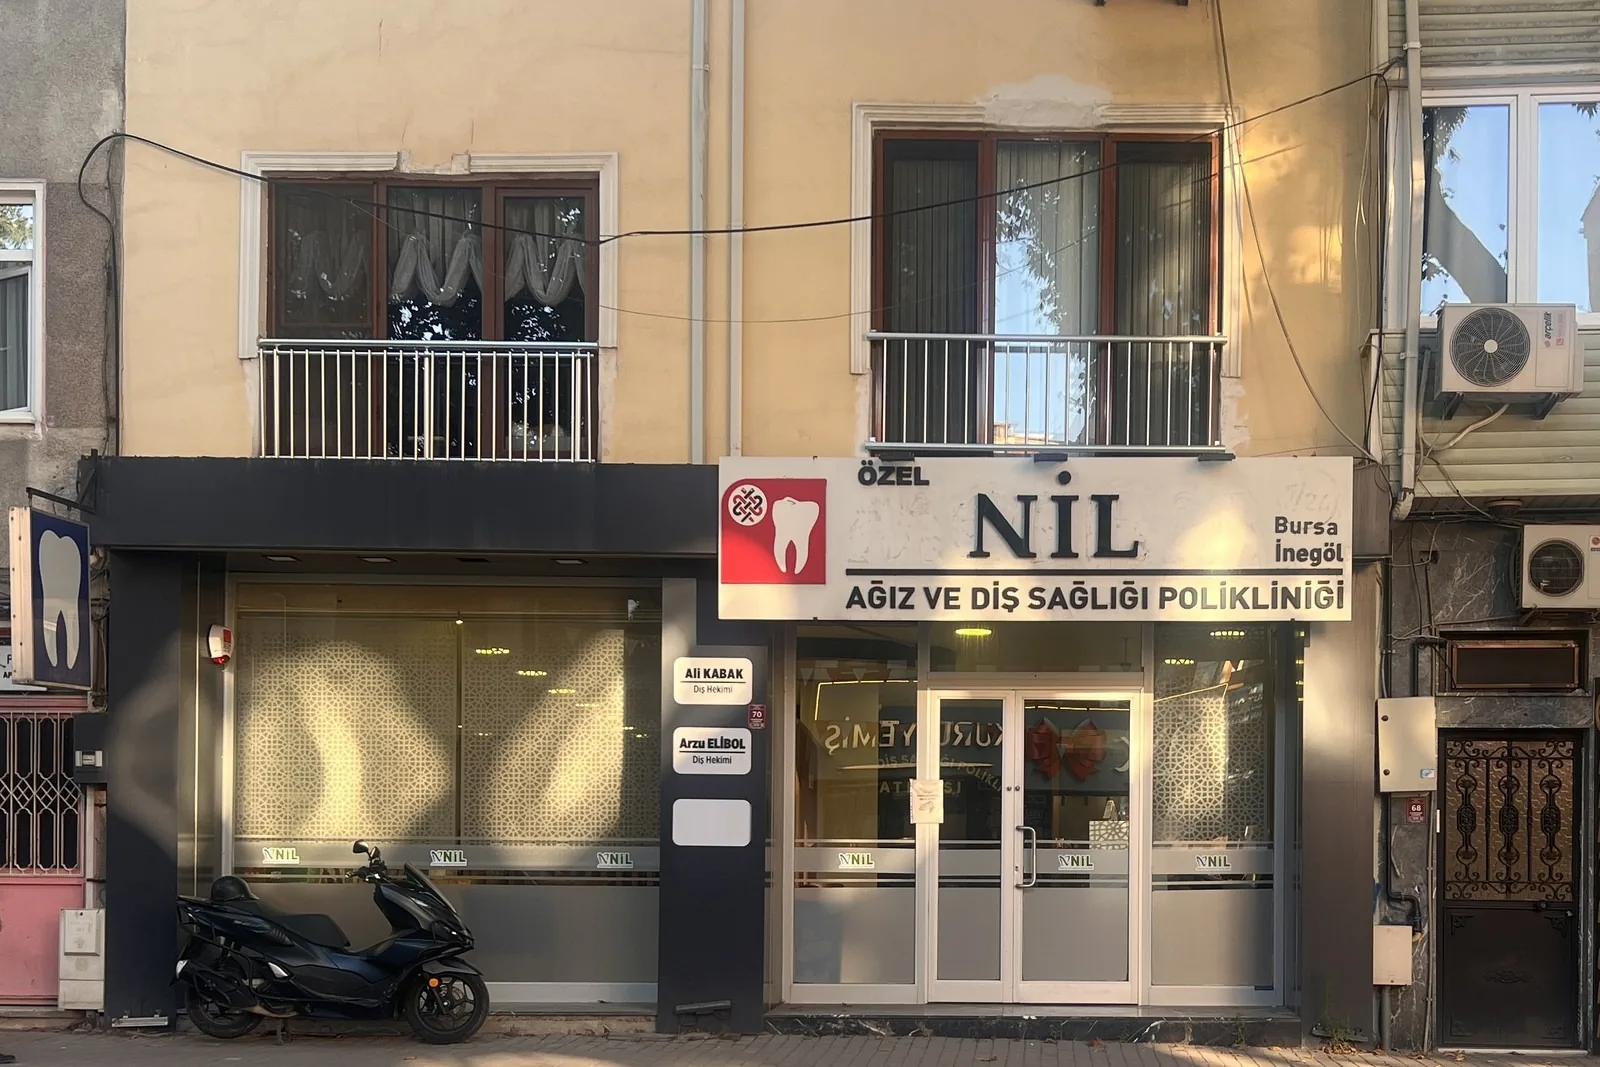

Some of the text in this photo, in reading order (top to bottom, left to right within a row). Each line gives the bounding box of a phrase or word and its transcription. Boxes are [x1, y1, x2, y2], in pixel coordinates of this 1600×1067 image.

[858, 460, 930, 486] ÖZEL
[968, 471, 1139, 559] NİL
[1274, 516, 1338, 536] Bursa
[1275, 538, 1344, 567] İnegöl
[846, 580, 1344, 612] AĞIZ VE DİŞ SAĞLIĞI POLİKLİNİĞİ
[685, 668, 744, 680] Ali KABAK
[707, 685, 733, 694] Hekimi
[679, 736, 746, 750] Arzu ELİBOL
[692, 756, 733, 765] Diş Hekimi
[1411, 804, 1422, 812] 68
